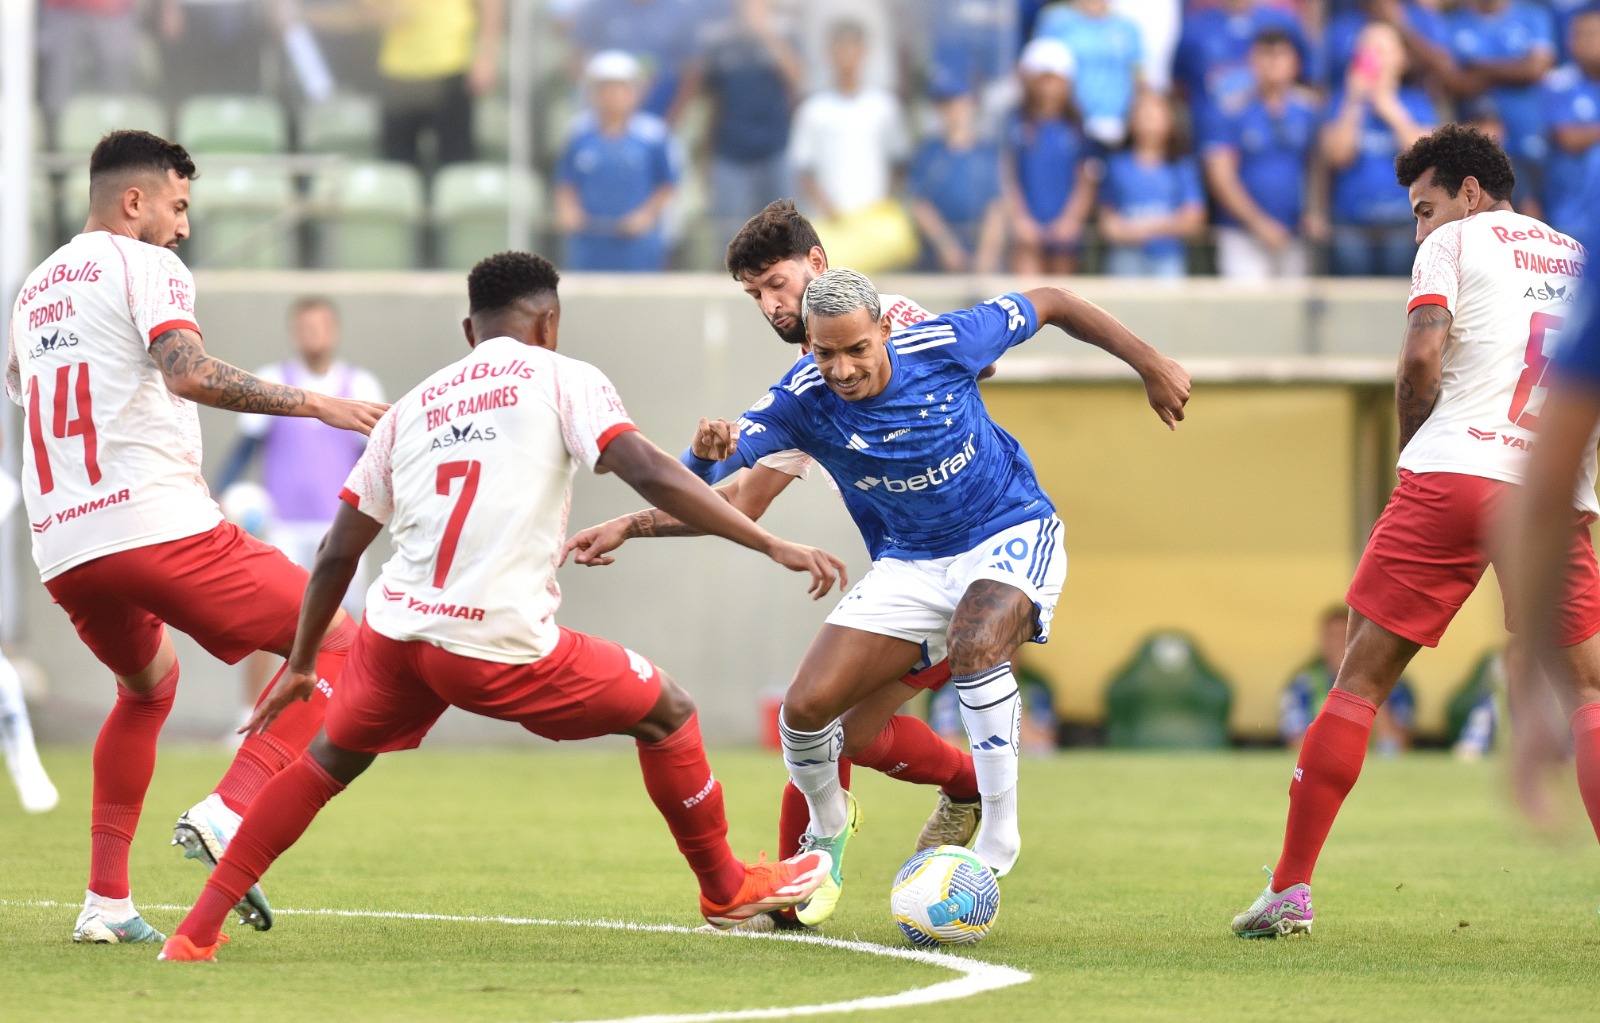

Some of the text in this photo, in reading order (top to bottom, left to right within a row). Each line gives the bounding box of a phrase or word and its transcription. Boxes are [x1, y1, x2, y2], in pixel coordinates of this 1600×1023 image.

[1491, 225, 1589, 258] Red Bull
[1513, 249, 1585, 278] EVANGELIST
[18, 261, 102, 312] Red Bulls
[28, 296, 76, 331] PEDRO H.
[421, 360, 535, 407] Red Bulls
[25, 362, 102, 496] 14
[426, 386, 518, 432] ERIC RAMIRES
[736, 416, 767, 436] urf
[883, 427, 911, 443] LAVITAN
[882, 433, 976, 493] betfair
[56, 488, 130, 524] YANMAR
[433, 459, 482, 589] 7
